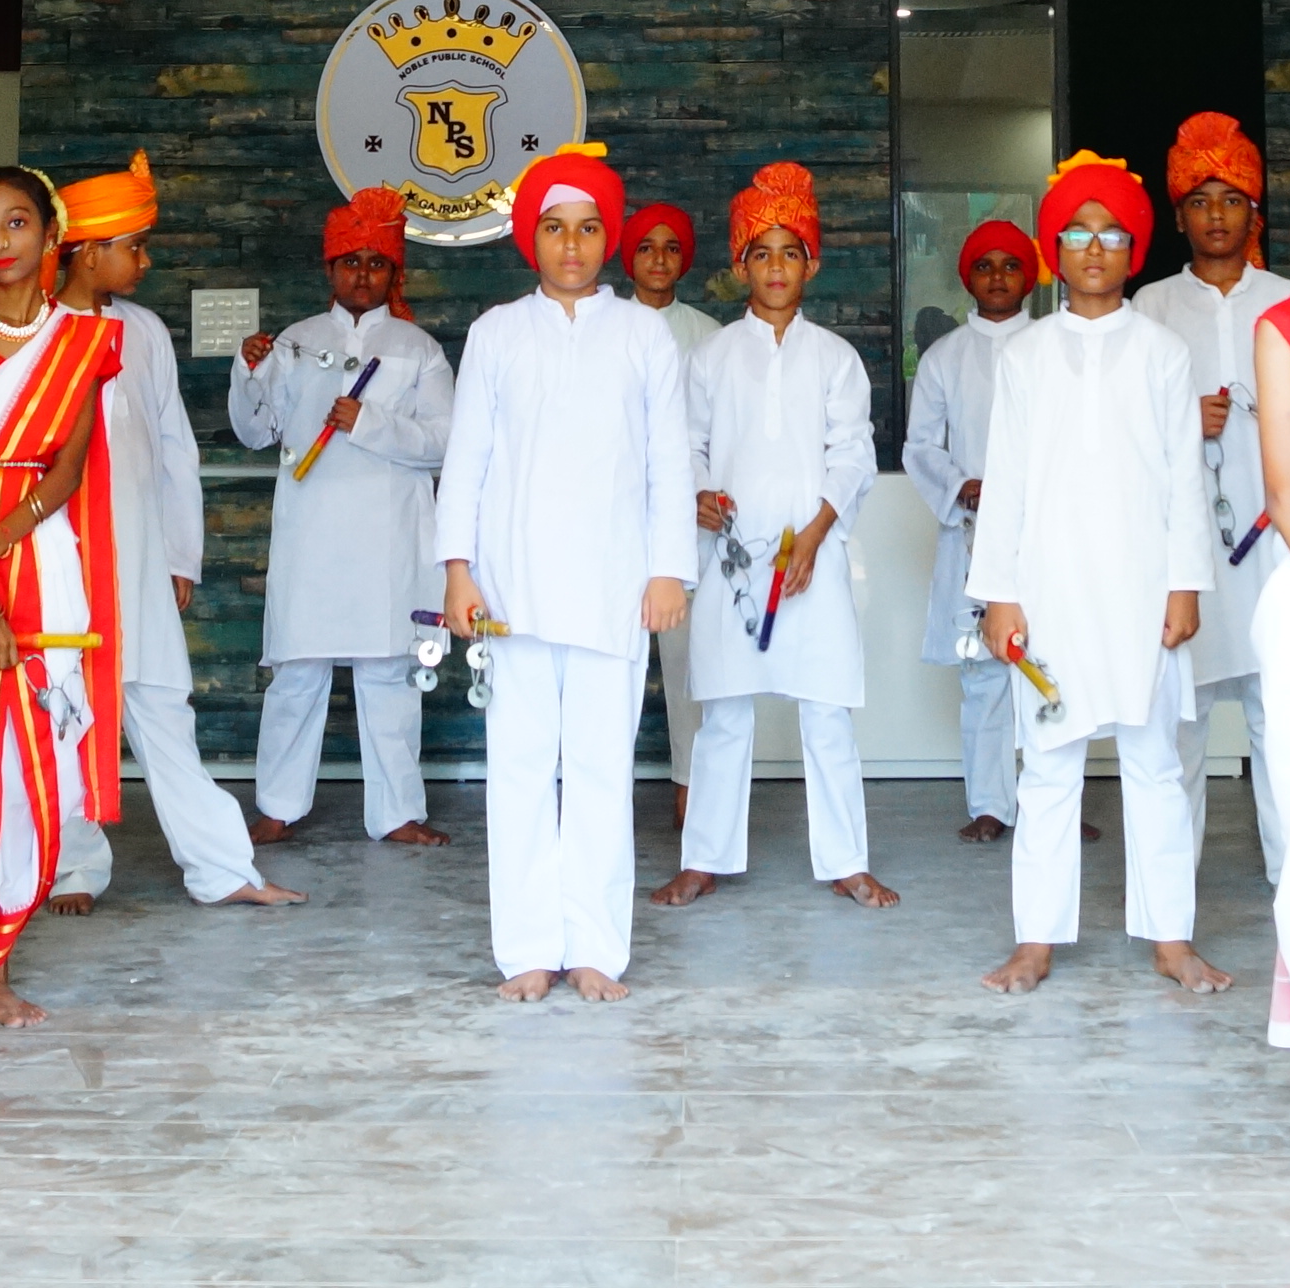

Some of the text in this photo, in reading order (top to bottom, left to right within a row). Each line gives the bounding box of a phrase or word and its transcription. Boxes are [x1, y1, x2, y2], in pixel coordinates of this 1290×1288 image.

[398, 52, 507, 81] NOBLE PUBLIC SCHOOL
[418, 198, 485, 214] GAJRAULA
